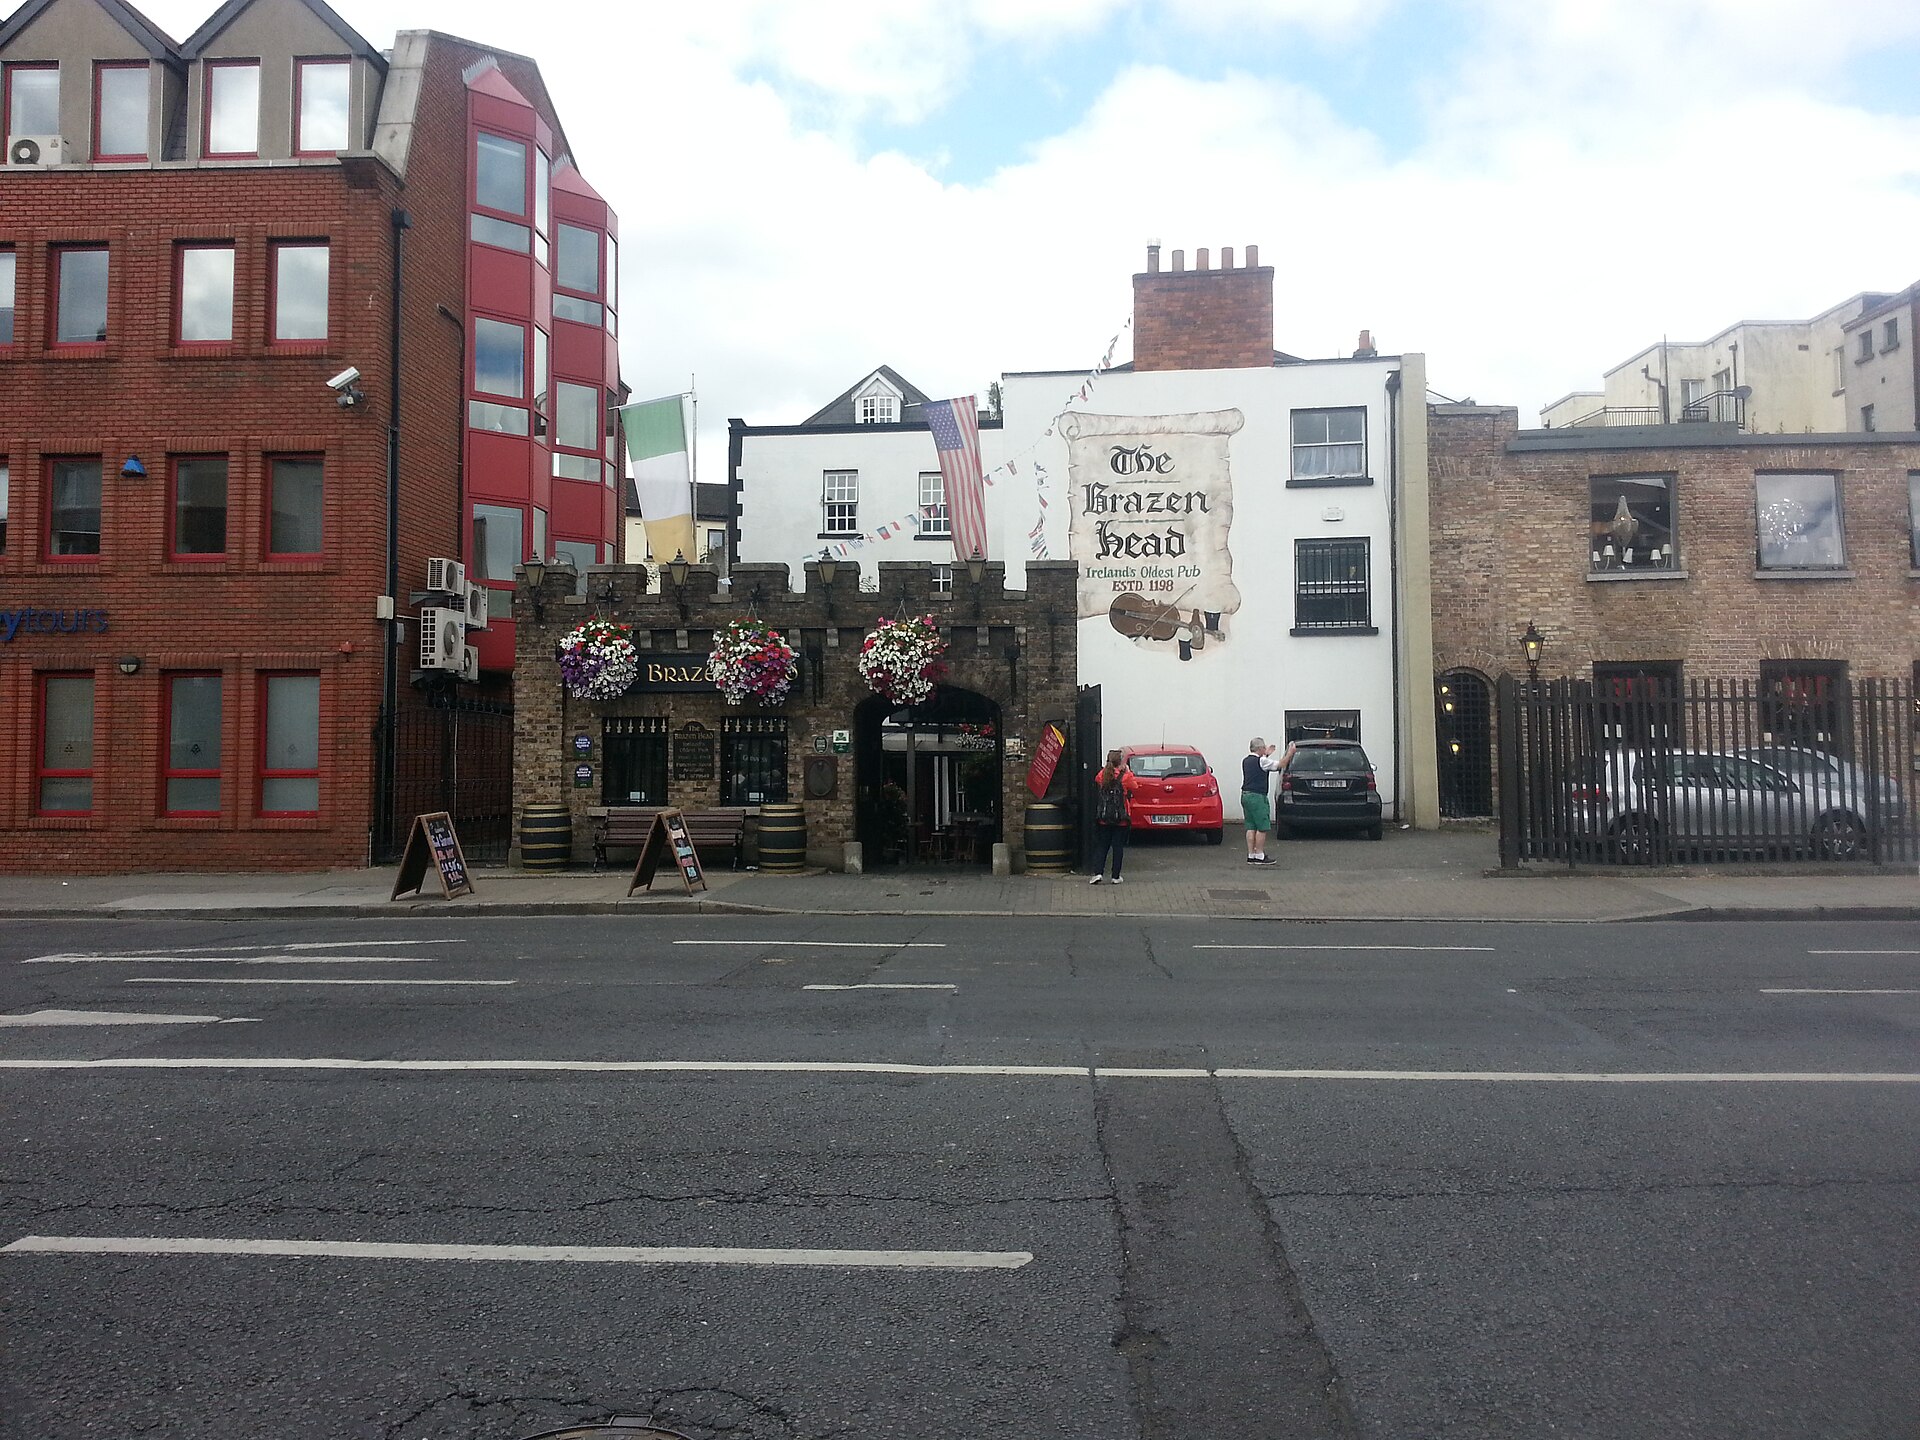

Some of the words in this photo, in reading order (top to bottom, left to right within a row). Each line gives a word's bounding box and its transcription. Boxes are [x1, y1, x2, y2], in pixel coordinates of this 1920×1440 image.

[1110, 443, 1176, 475] The
[1081, 481, 1212, 517] Brazen
[1140, 565, 1174, 578] Oldest
[1177, 565, 1201, 578] Pub
[1149, 580, 1174, 592] 1198
[0, 607, 109, 642] ytours
[648, 663, 718, 683] BRAZE
